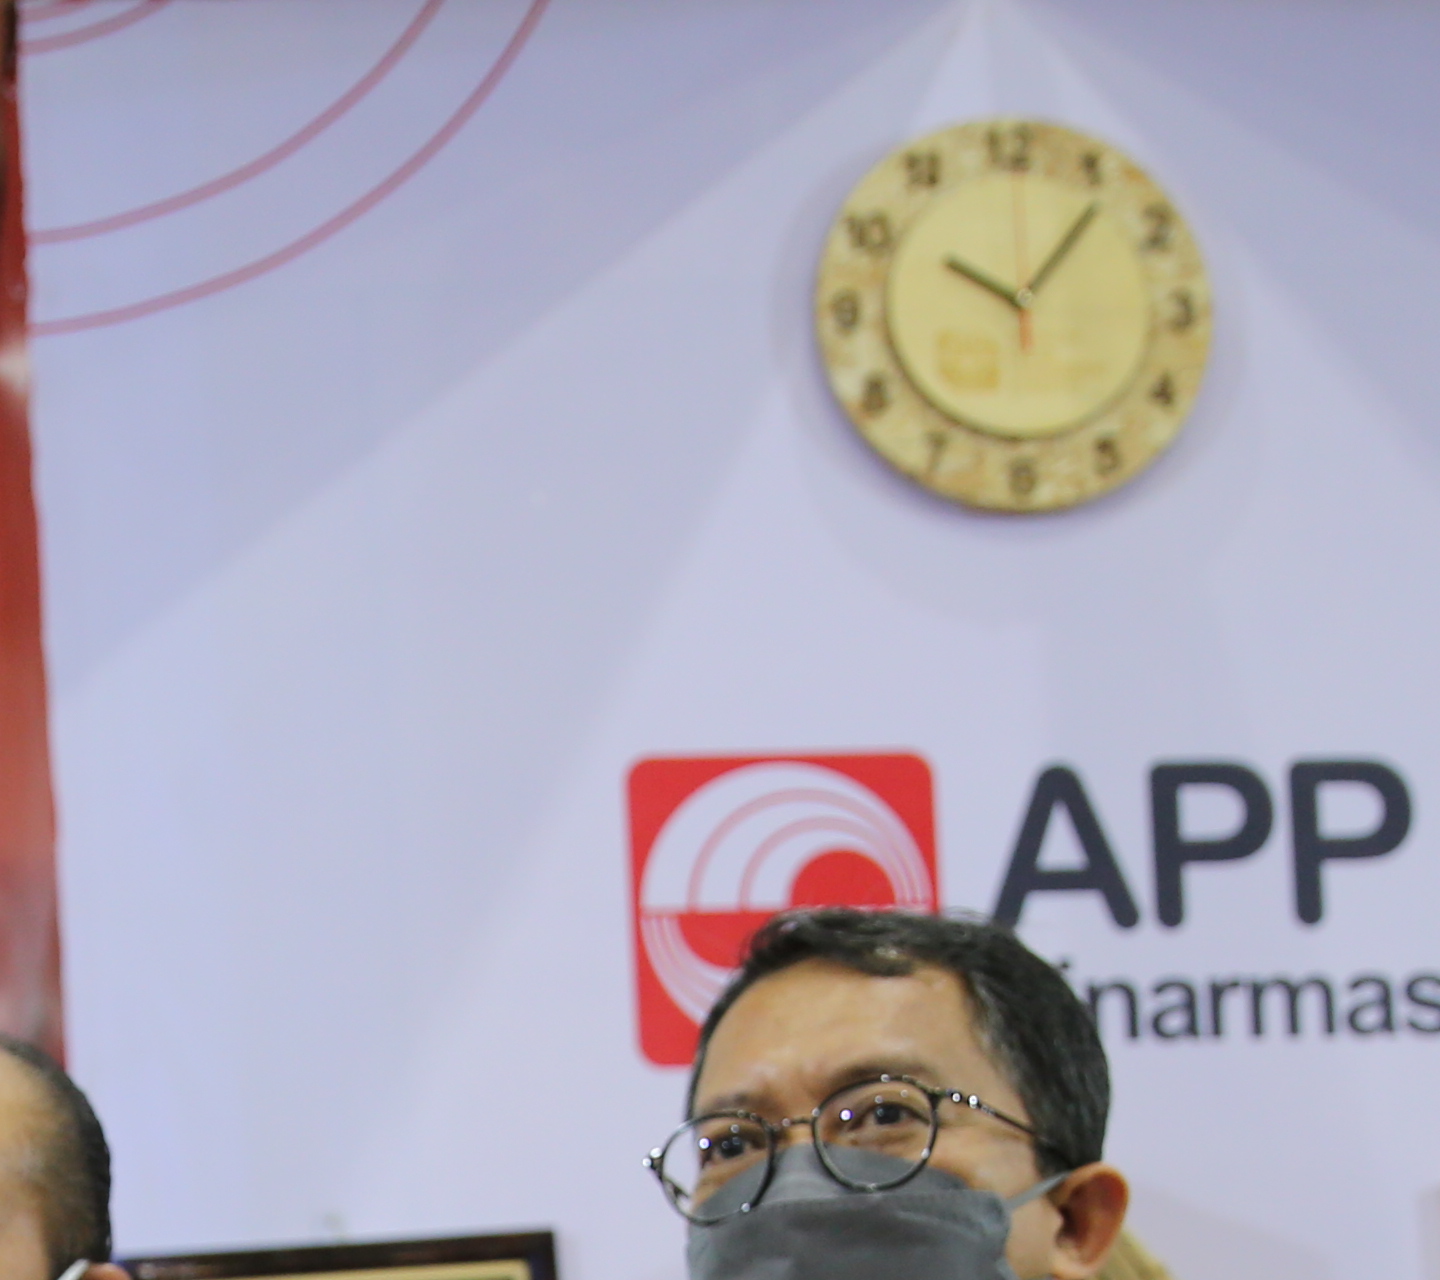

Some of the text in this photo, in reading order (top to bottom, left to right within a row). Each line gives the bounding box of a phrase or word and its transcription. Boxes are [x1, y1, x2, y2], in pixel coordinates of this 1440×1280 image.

[986, 124, 1032, 174] 12
[845, 212, 891, 254] 10
[1143, 203, 1171, 253] 2
[1169, 288, 1195, 332] 3
[991, 760, 1413, 928] APP
